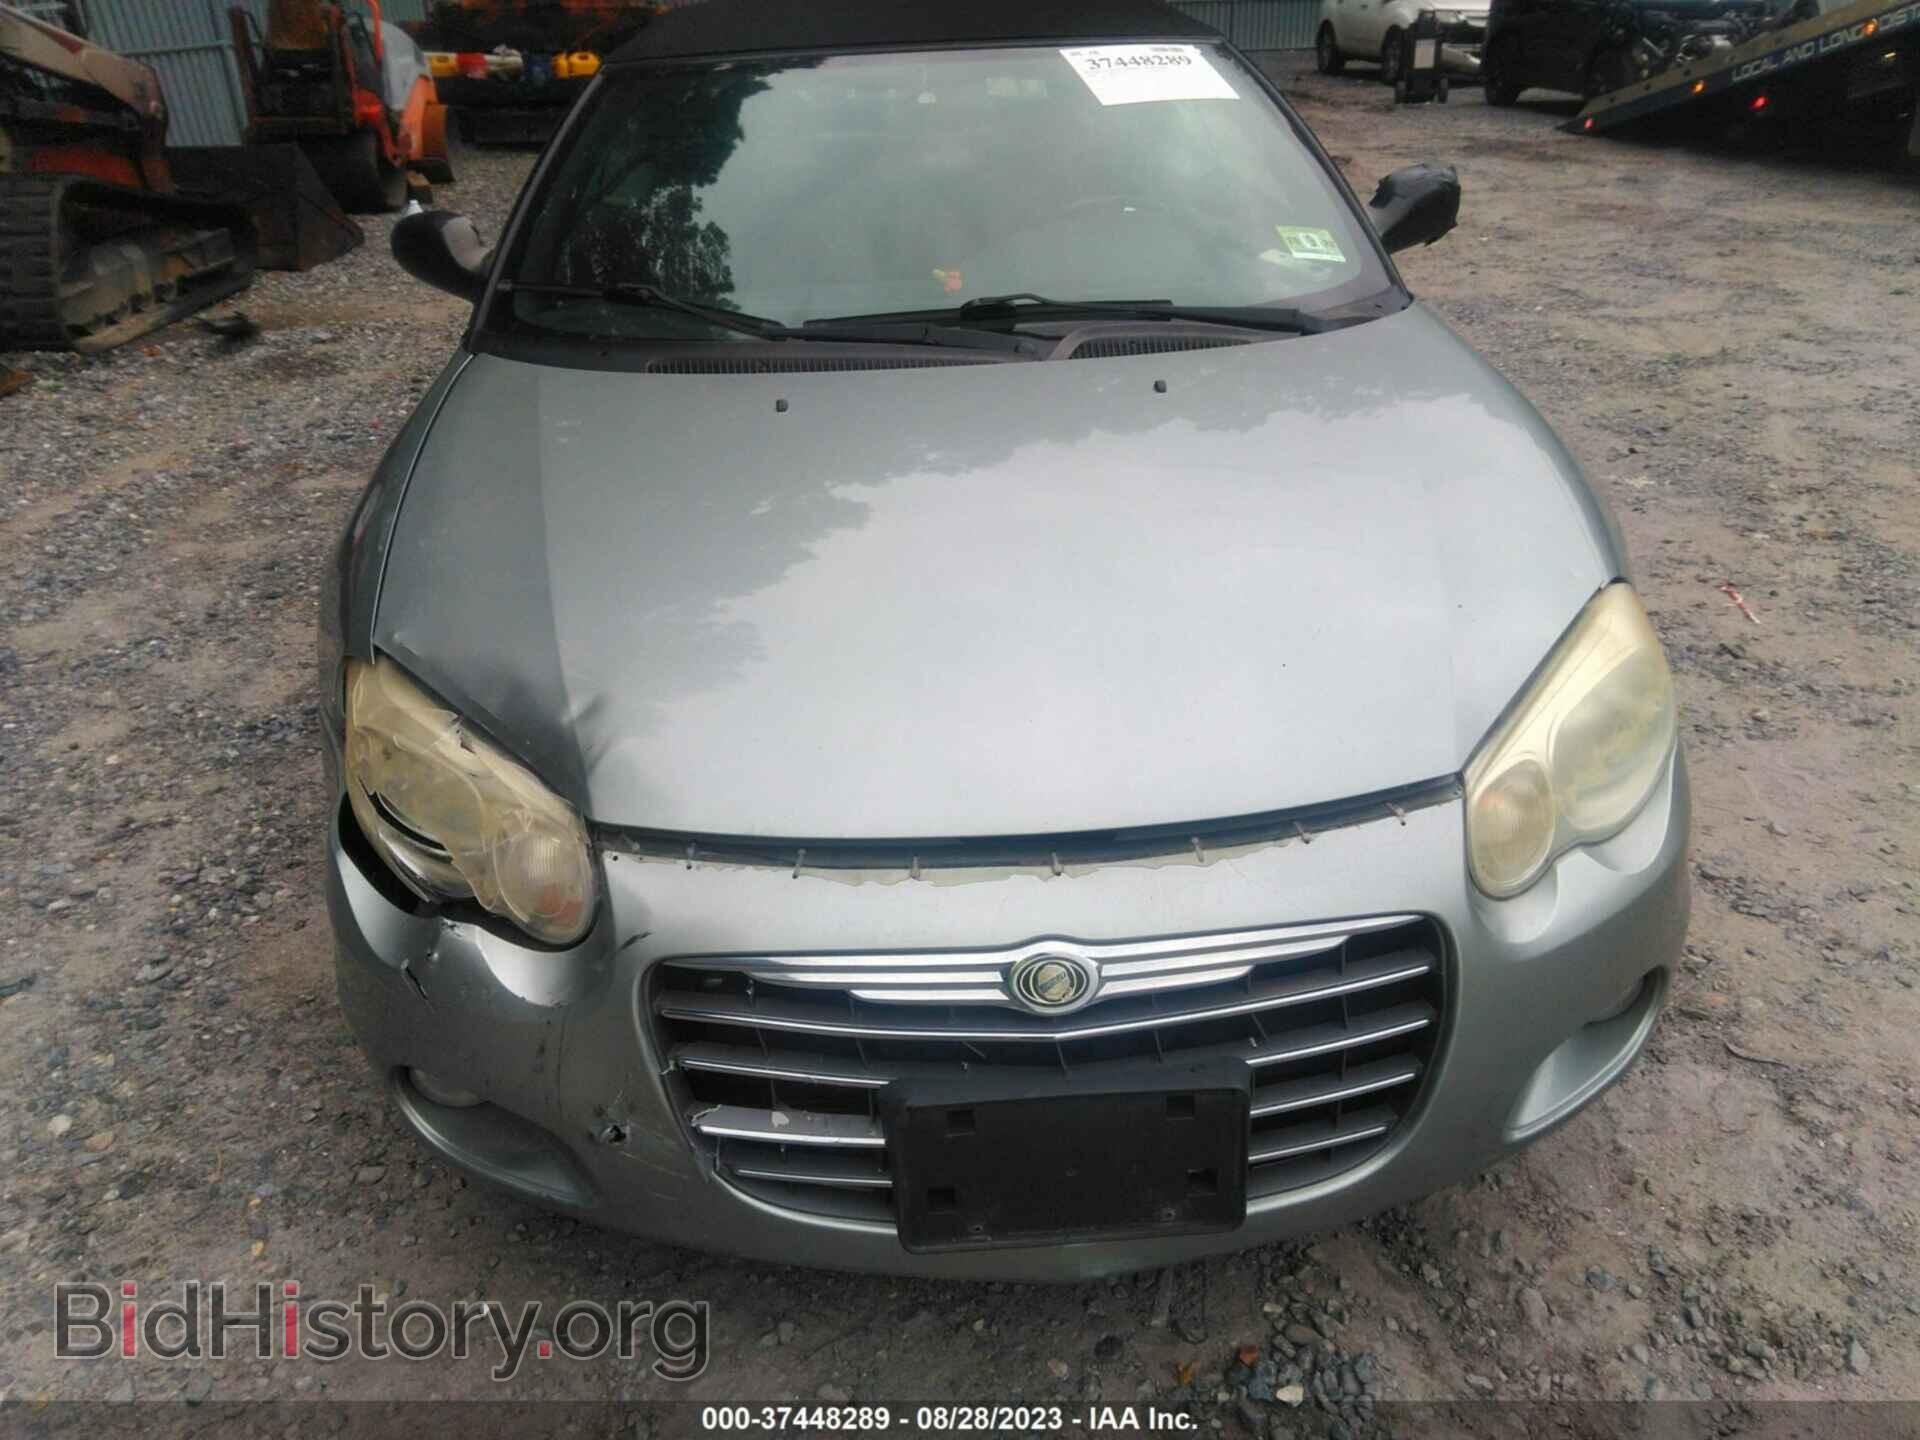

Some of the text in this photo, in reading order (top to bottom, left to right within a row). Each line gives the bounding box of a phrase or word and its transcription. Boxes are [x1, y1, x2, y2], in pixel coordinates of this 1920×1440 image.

[1086, 55, 1192, 70] 37448289
[1731, 58, 1777, 82] LOCAL
[1783, 41, 1815, 65] AND
